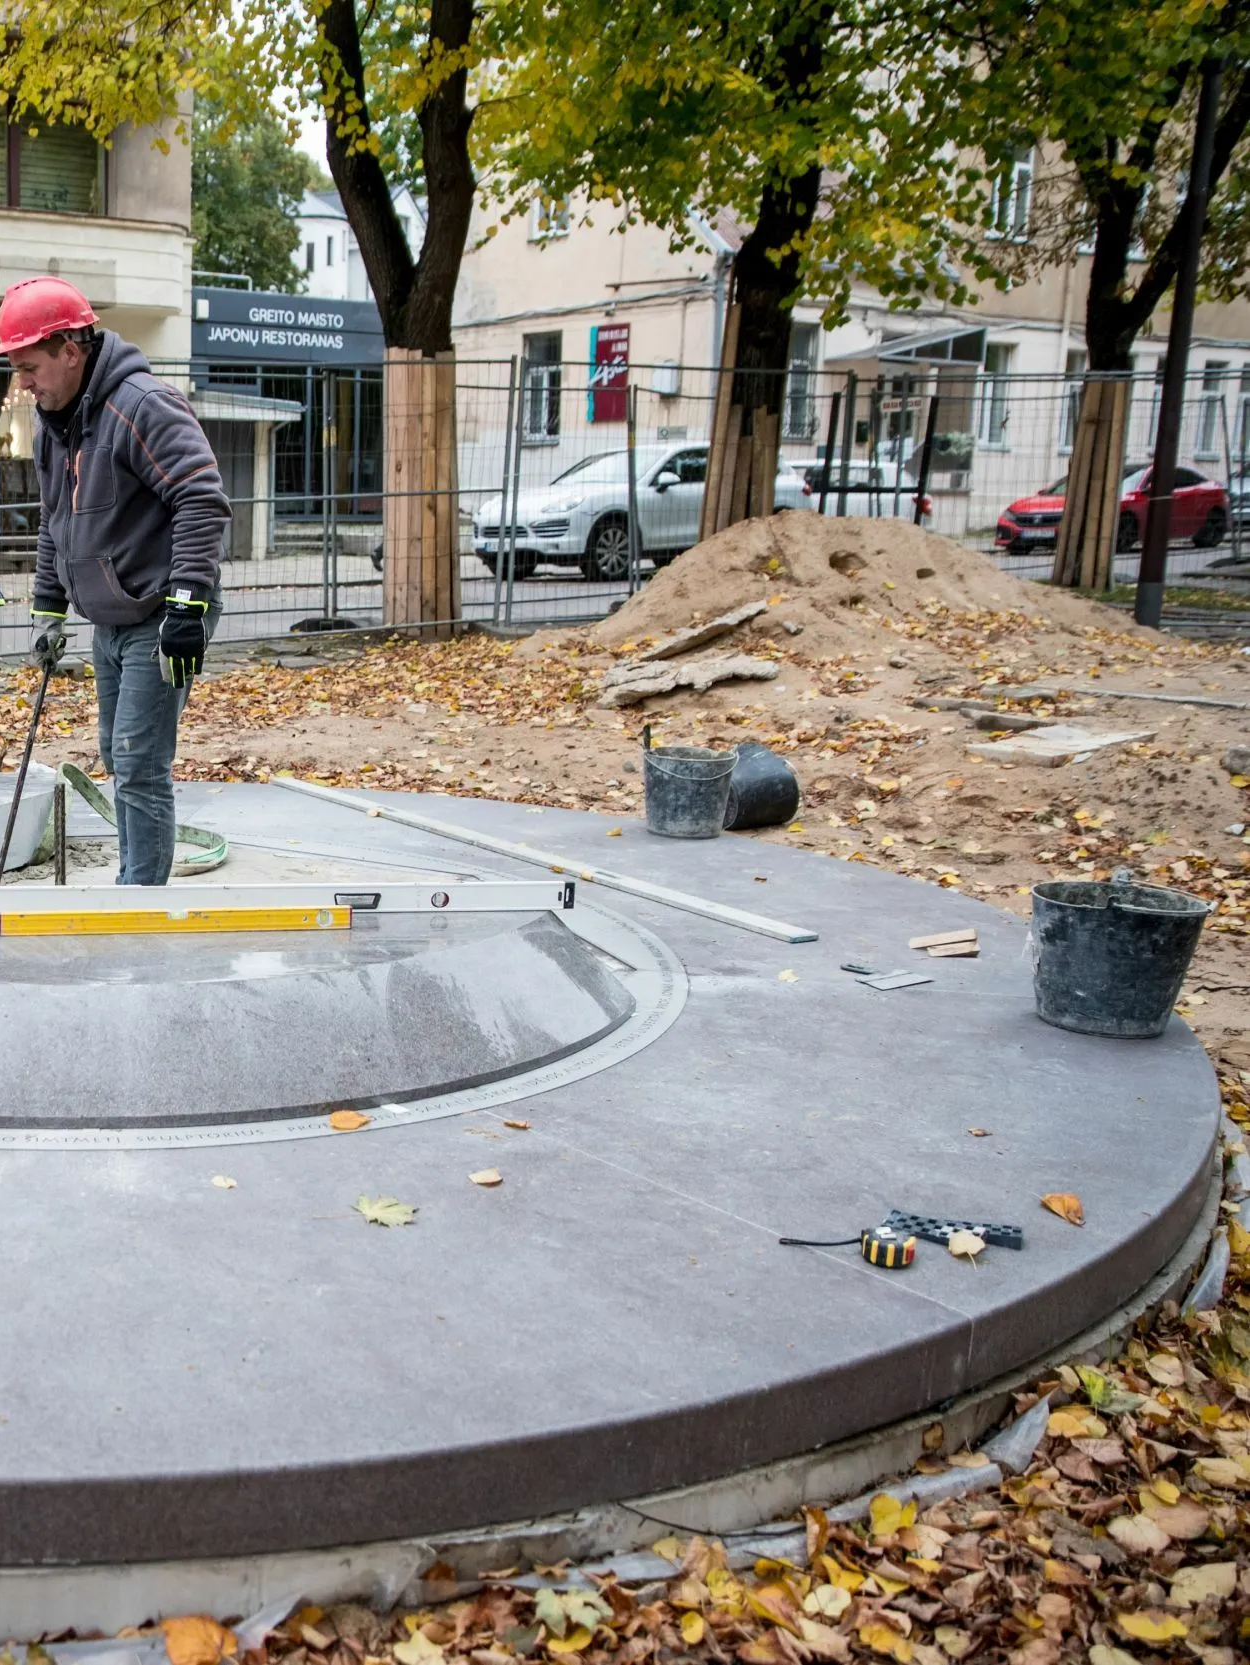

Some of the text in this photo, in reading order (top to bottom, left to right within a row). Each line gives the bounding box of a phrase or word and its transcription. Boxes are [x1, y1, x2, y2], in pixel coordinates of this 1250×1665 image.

[249, 307, 344, 329] GREITO MAISTO
[208, 327, 343, 349] JAPONŲ RESTORANAS
